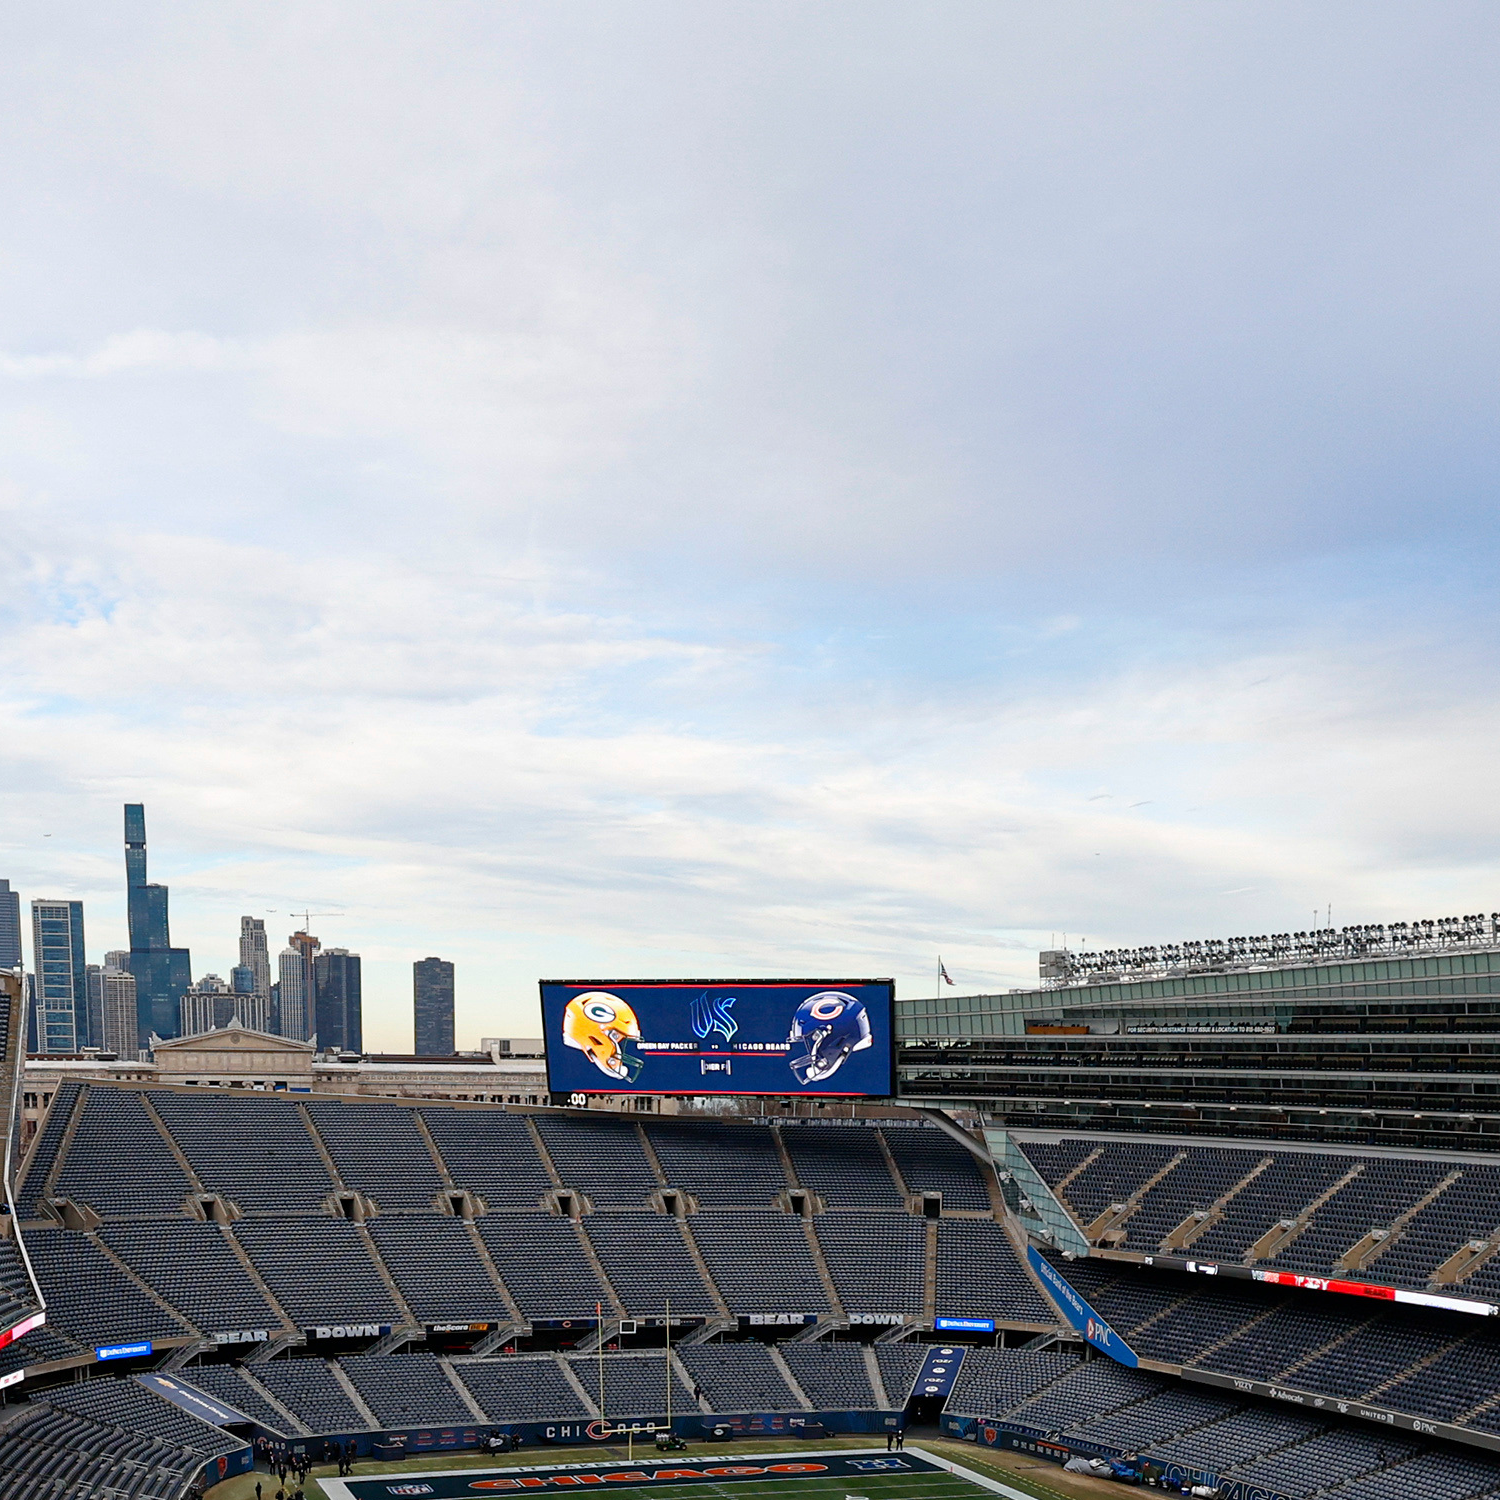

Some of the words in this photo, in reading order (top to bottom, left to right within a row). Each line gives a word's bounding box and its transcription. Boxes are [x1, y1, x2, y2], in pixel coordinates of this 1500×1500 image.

[657, 1042, 670, 1050] BAY
[749, 1313, 805, 1326] BEAR
[849, 1313, 904, 1326] DOWN
[215, 1330, 269, 1344] BEAR
[315, 1325, 380, 1339] DOWN
[1094, 1322, 1112, 1347] PNC
[1276, 1390, 1304, 1404] Advocate
[1360, 1409, 1386, 1421] UNITED
[546, 1419, 656, 1441] CHICAGO
[1421, 1420, 1437, 1435] PNC
[468, 1462, 829, 1489] CHICAGO
